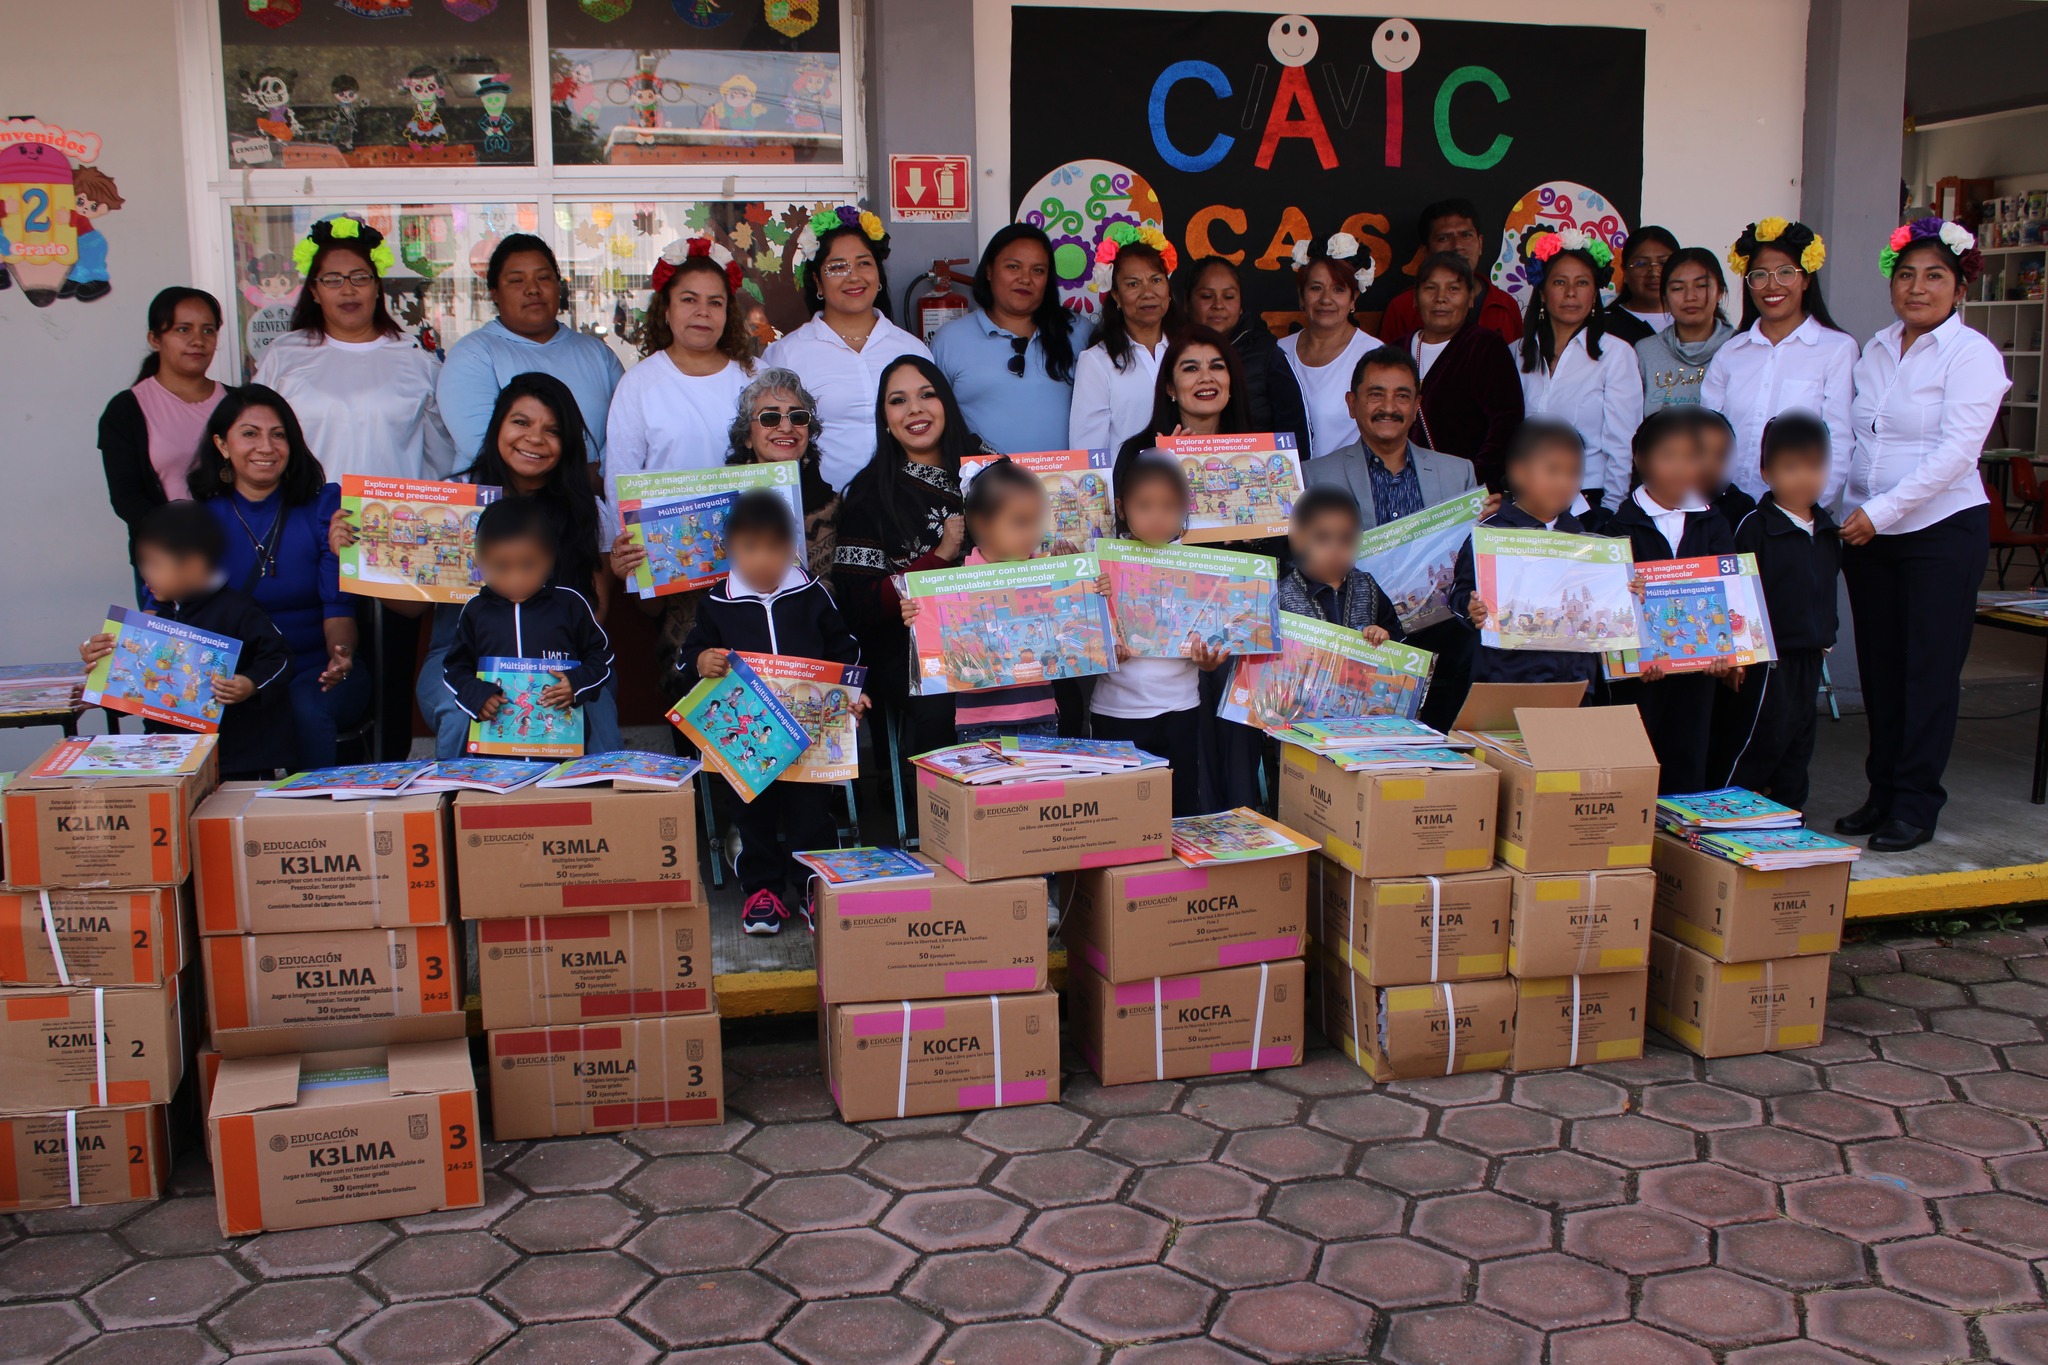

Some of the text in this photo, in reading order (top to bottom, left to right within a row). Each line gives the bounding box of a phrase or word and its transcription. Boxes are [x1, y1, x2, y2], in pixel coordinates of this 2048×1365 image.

[235, 143, 269, 154] CENSADO
[22, 188, 51, 232] 2
[10, 241, 69, 257] Grado
[253, 321, 293, 333] BIENVENI
[1175, 439, 1205, 447] Explorar
[1212, 438, 1242, 447] imaginar
[1214, 444, 1251, 452] preescolar
[1277, 436, 1285, 448] 1
[774, 465, 788, 484] 3
[364, 480, 397, 490] Explorar
[406, 483, 441, 494] imaginar
[480, 490, 489, 505] 1
[658, 497, 730, 517] Múltiples lenguajes
[1470, 497, 1484, 515] 3
[1608, 544, 1621, 562] 3
[920, 574, 946, 585] Jugar
[956, 569, 996, 582] imaginar
[998, 568, 1016, 576] con
[1017, 565, 1029, 573] mi
[1030, 560, 1067, 571] material
[1074, 558, 1089, 577] 2
[1253, 559, 1267, 576] 2
[1720, 560, 1731, 573] 3
[936, 573, 1056, 593] manipulable de preescolar
[1646, 585, 1715, 598] Múltiples lenguajes
[147, 620, 230, 651] Múltiples lenguajes
[542, 650, 562, 660] LIAM
[500, 662, 537, 672] Múltiples
[1403, 652, 1418, 673] 2
[844, 670, 854, 684] 1
[750, 679, 801, 741] Múltiples lenguajes
[141, 707, 207, 732] Preescolar. Tercer grado
[703, 744, 748, 793] Preescolar. Primer grado
[810, 769, 852, 780] Fungible
[1310, 784, 1332, 806] K1MLA
[987, 805, 1029, 816] EDUCACIÓN
[1039, 801, 1099, 821] K0LPM
[1574, 802, 1615, 816] K1LPA
[1641, 808, 1648, 824] 1
[57, 815, 130, 832] K2LMA
[1415, 813, 1453, 826] K1MLA
[1478, 818, 1485, 832] 1
[1516, 810, 1522, 830] 1
[1355, 820, 1360, 838] 1
[152, 827, 168, 847] 2
[484, 832, 534, 843] EDUCACIÓN
[1052, 835, 1061, 843] 50
[1142, 833, 1163, 841] 24-25
[263, 838, 327, 851] EDUCACIÓN
[542, 838, 609, 856] K3MLA
[412, 843, 430, 868] 3
[661, 845, 678, 868] 3
[281, 854, 362, 875] K3LMA
[556, 871, 600, 879] 50 Ejemplares
[659, 872, 682, 880] 24-25
[410, 881, 436, 889] 24-25
[302, 893, 346, 902] 30 Ejemplares
[1139, 896, 1178, 907] EDUCACIÓN
[1187, 895, 1239, 915] K0CFA
[1773, 899, 1807, 912] K1MLA
[1828, 903, 1834, 916] 1
[853, 916, 897, 926] EDUCACIÓN
[1570, 913, 1608, 926] K1MLA
[1715, 907, 1721, 925] 1
[908, 920, 967, 938] K0CFA
[1278, 925, 1297, 934] 24-25
[1492, 919, 1499, 934] 1
[1633, 918, 1639, 931] 1
[1196, 928, 1206, 936] 50
[133, 930, 149, 949] 2
[503, 945, 553, 955] EDUCACIÓN
[279, 952, 342, 966] EDUCACIÓN
[561, 949, 627, 968] K3MLA
[1012, 956, 1035, 964] 24-25
[425, 956, 443, 980] 3
[677, 955, 693, 977] 3
[296, 967, 376, 990] K3LMA
[575, 982, 586, 990] 50
[675, 982, 696, 990] 24-25
[424, 992, 449, 1001] 24-25
[1751, 992, 1786, 1005] K1MLA
[1809, 996, 1815, 1009] 1
[317, 1006, 360, 1015] 30 Ejemplares
[1178, 1004, 1232, 1023] K0CFA
[1629, 1007, 1636, 1021] 1
[1693, 1000, 1698, 1018] 1
[1499, 1020, 1506, 1035] 1
[870, 1036, 913, 1046] EDUCACIN
[924, 1036, 980, 1055] K0CFA
[1272, 1035, 1292, 1043] 24-25
[131, 1040, 145, 1058] 2
[516, 1055, 566, 1065] EDUCACIÓN
[573, 1059, 638, 1077] K3MLA
[1025, 1069, 1046, 1078] 24-25
[688, 1065, 704, 1087] 3
[685, 1091, 707, 1099] 24-25
[290, 1127, 359, 1144] EDUCACIÓN
[449, 1125, 468, 1150] 3
[129, 1145, 144, 1164] 2
[309, 1140, 396, 1168] K3LMA
[447, 1161, 473, 1172] 24-25
[320, 1175, 352, 1184] Preescolar.
[371, 1170, 390, 1179] grado
[333, 1182, 379, 1193] 30 Ejemplares
